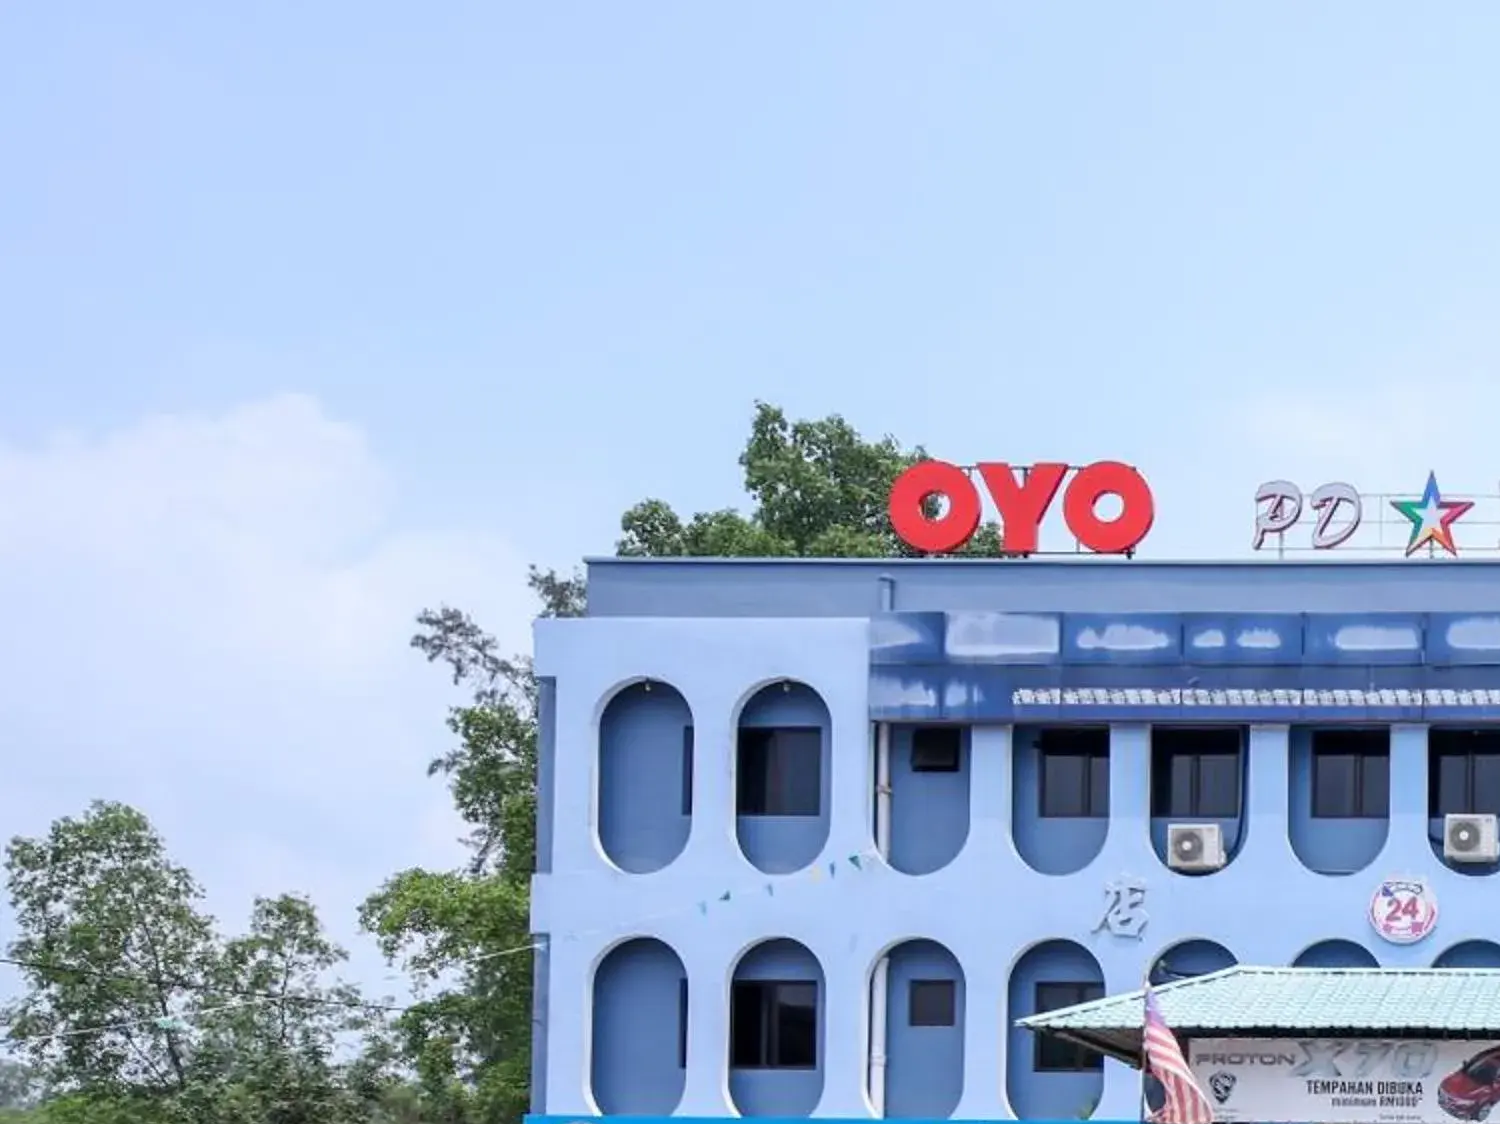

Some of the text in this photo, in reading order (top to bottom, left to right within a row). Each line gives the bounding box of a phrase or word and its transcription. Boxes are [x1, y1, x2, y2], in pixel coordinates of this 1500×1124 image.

[888, 459, 1154, 553] OYO
[1252, 480, 1362, 550] PD
[1385, 897, 1419, 922] 24
[1196, 1038, 1439, 1079] PROTON X70
[1307, 1080, 1373, 1096] TEMPAHAN
